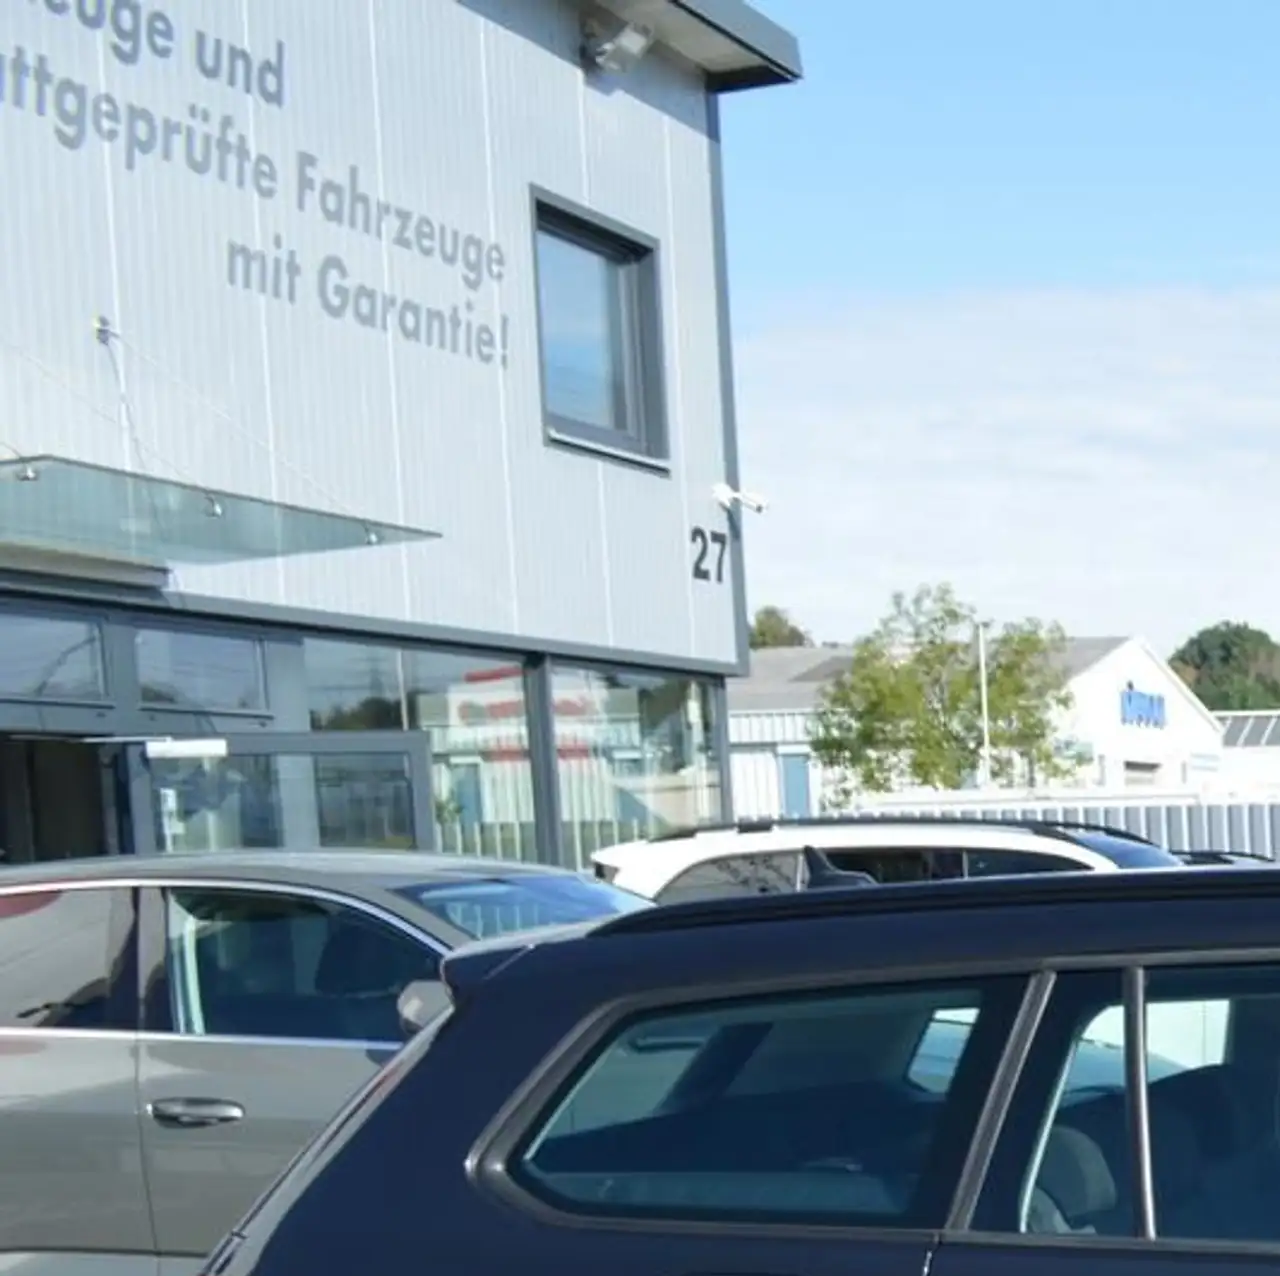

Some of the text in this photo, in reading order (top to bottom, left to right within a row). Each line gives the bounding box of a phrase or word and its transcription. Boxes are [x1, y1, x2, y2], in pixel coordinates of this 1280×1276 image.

[194, 29, 286, 109] und
[0, 44, 506, 292] ttgeprüfte Fahrzeuge
[226, 233, 510, 370] mit Garantie!
[690, 526, 727, 583] 27
